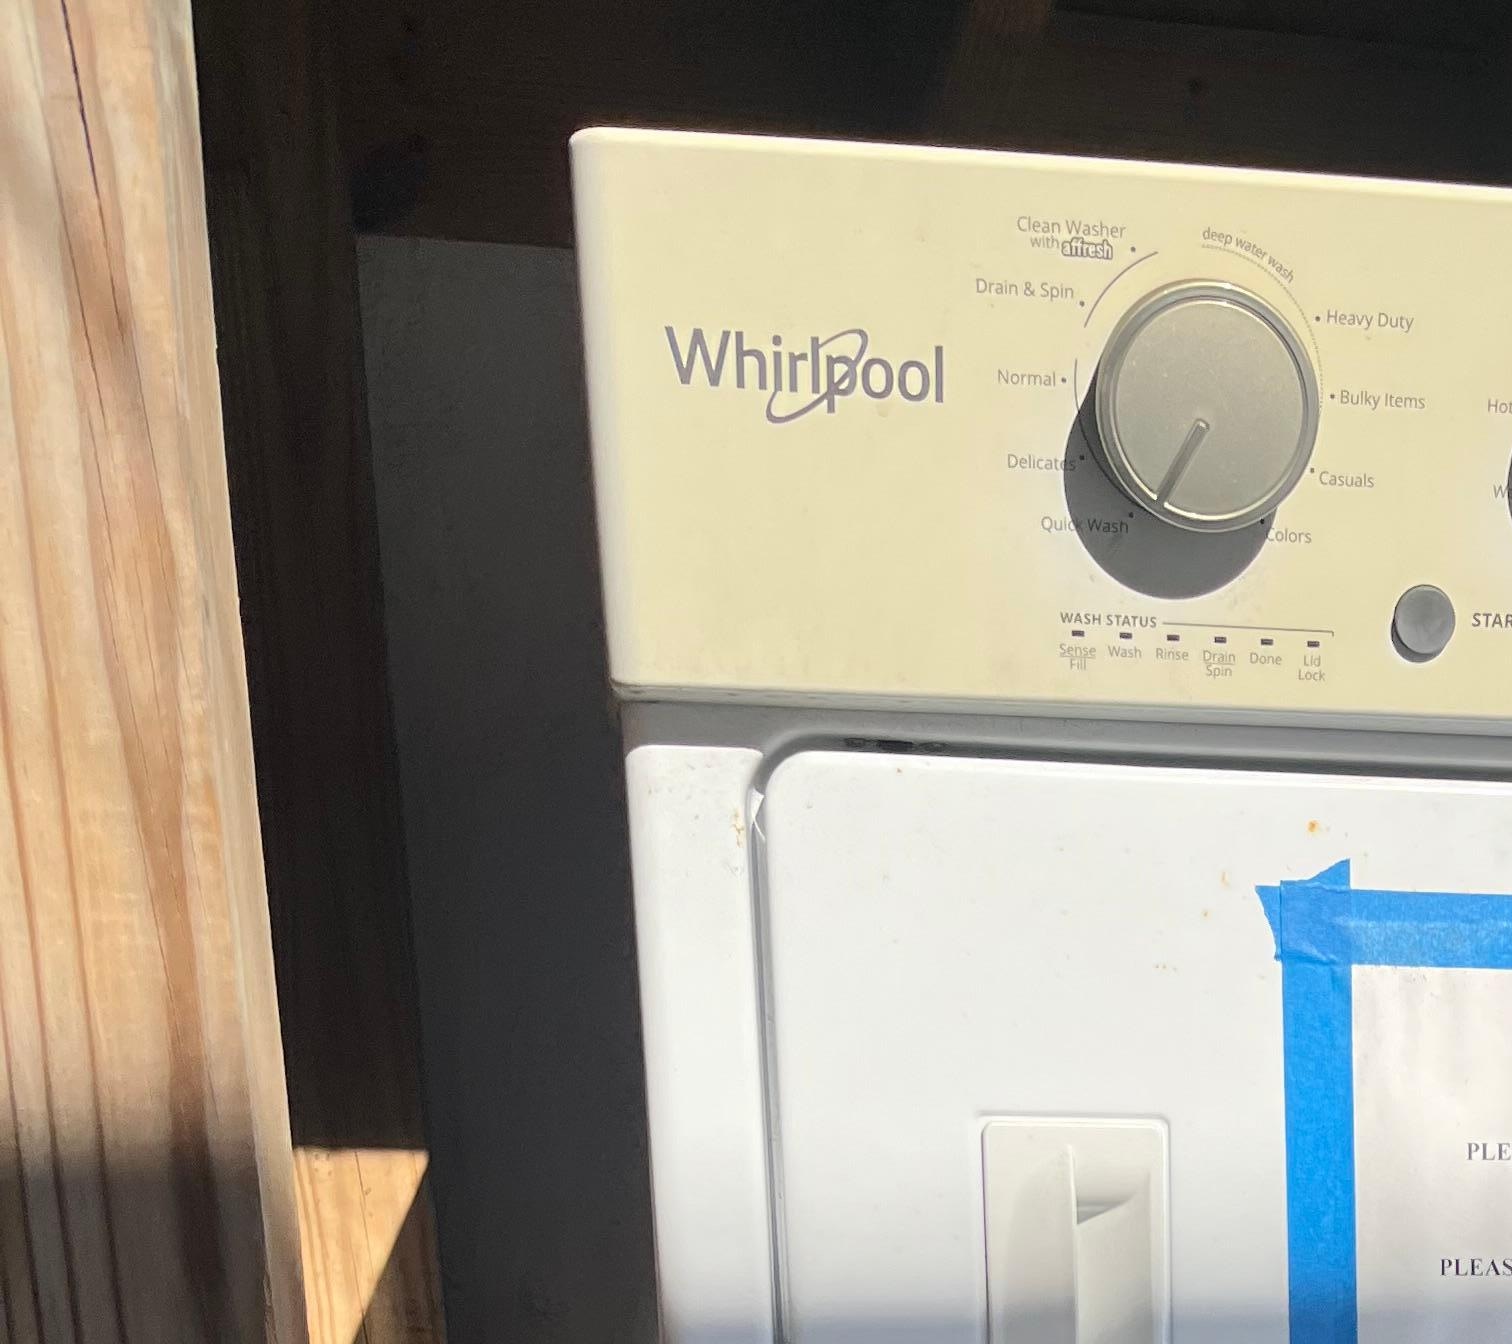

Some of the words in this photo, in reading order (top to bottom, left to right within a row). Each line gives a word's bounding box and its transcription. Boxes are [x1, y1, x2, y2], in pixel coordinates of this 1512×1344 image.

[1017, 216, 1060, 234] Clean
[1066, 220, 1126, 238] Washer
[1030, 235, 1059, 249] with
[1061, 237, 1113, 260] affresh
[1202, 226, 1233, 247] deep
[1236, 237, 1267, 260] water
[1268, 256, 1294, 283] wash
[976, 278, 1018, 296] Drain
[1023, 281, 1035, 297] &
[1040, 282, 1074, 301] Spin
[1327, 310, 1373, 330] Heavy
[1377, 313, 1414, 332] Duty
[664, 326, 943, 422] Whirlpool
[997, 370, 1056, 387] Normal
[1340, 390, 1380, 409] Bulky
[1385, 393, 1425, 410] Items
[1007, 454, 1077, 471] Delicates
[1319, 471, 1374, 488] Casuals
[1041, 516, 1082, 533] Quick
[1087, 519, 1129, 534] Wash
[1266, 527, 1312, 545] Colors
[1060, 612, 1101, 626] WASH
[1106, 614, 1157, 628] STATUS
[1059, 644, 1096, 657] Sense
[1108, 646, 1142, 659] Wash
[1155, 648, 1189, 661] Rinse
[1203, 650, 1236, 664] Drain
[1250, 652, 1282, 666] Done
[1070, 658, 1087, 671] Fill
[1303, 655, 1321, 667] Lid
[1206, 664, 1232, 678] Spin
[1298, 668, 1325, 682] Lock
